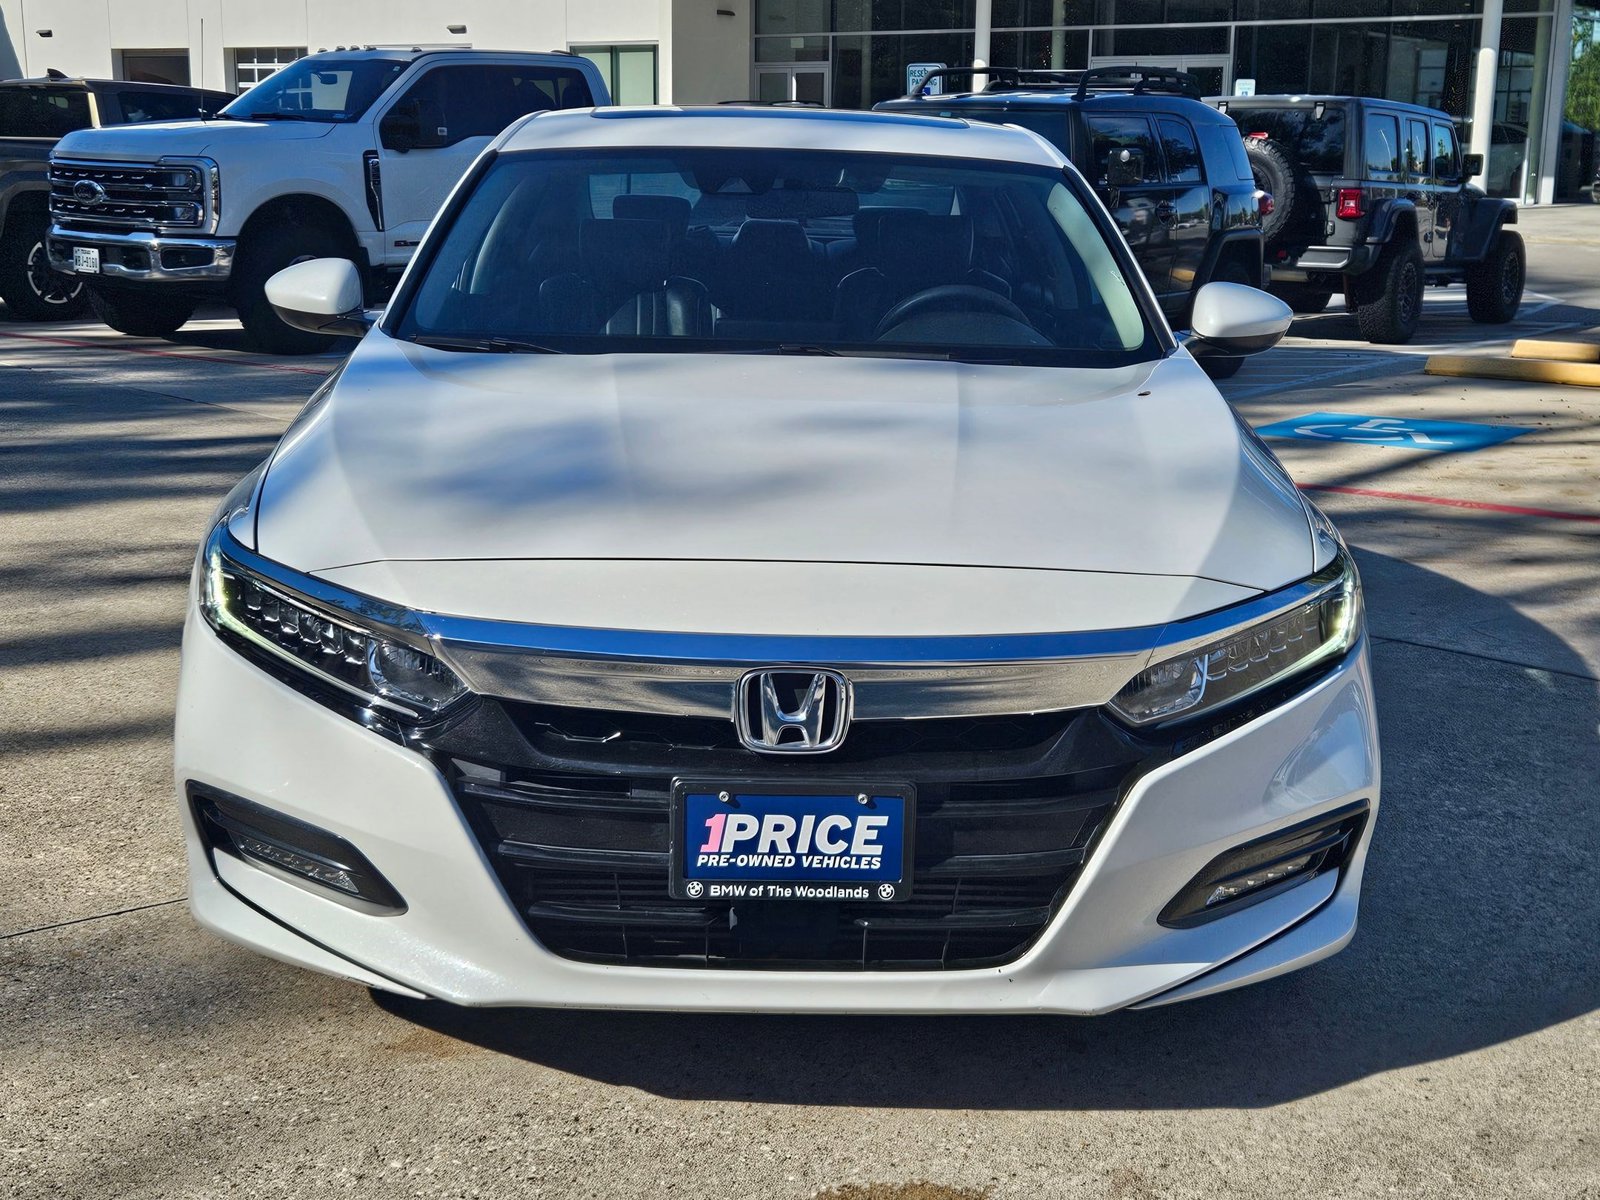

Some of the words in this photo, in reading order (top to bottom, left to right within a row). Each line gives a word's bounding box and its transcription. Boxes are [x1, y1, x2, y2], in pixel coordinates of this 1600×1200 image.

[697, 854, 796, 867] PRE-OWNED
[802, 855, 882, 870] VEHICLES
[709, 885, 747, 897] BMW
[749, 885, 764, 897] of
[767, 885, 792, 898] The
[794, 886, 869, 899] Woodlands
